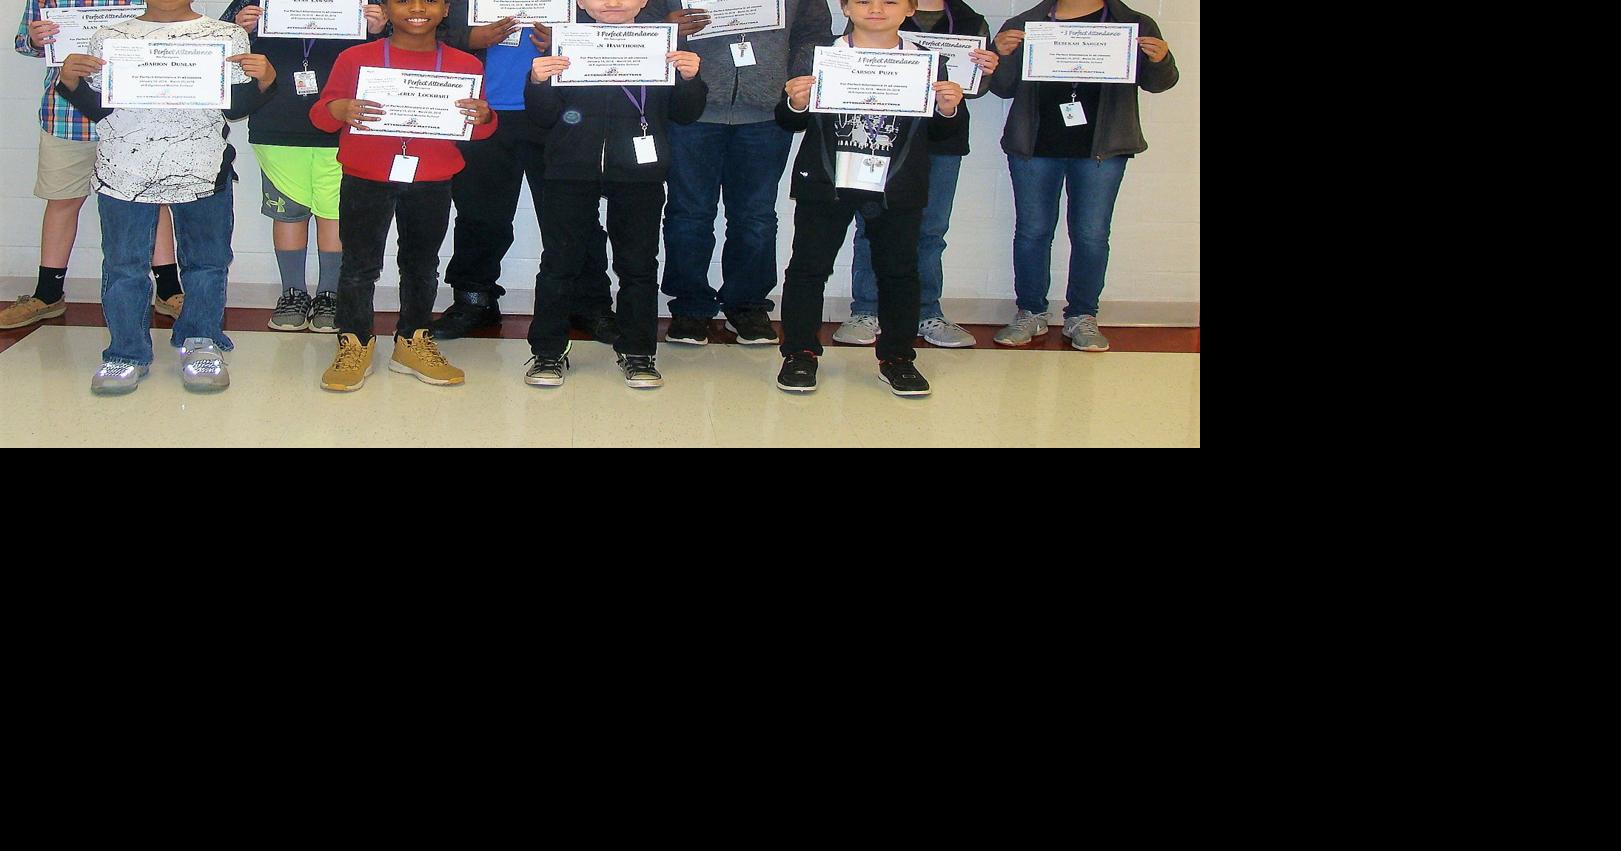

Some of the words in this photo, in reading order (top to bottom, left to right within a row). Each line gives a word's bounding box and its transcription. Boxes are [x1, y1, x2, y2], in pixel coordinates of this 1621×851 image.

[601, 30, 622, 38] Perfect
[154, 48, 176, 57] Perfect
[862, 57, 884, 65] Perfect
[407, 79, 428, 88] Perfect
